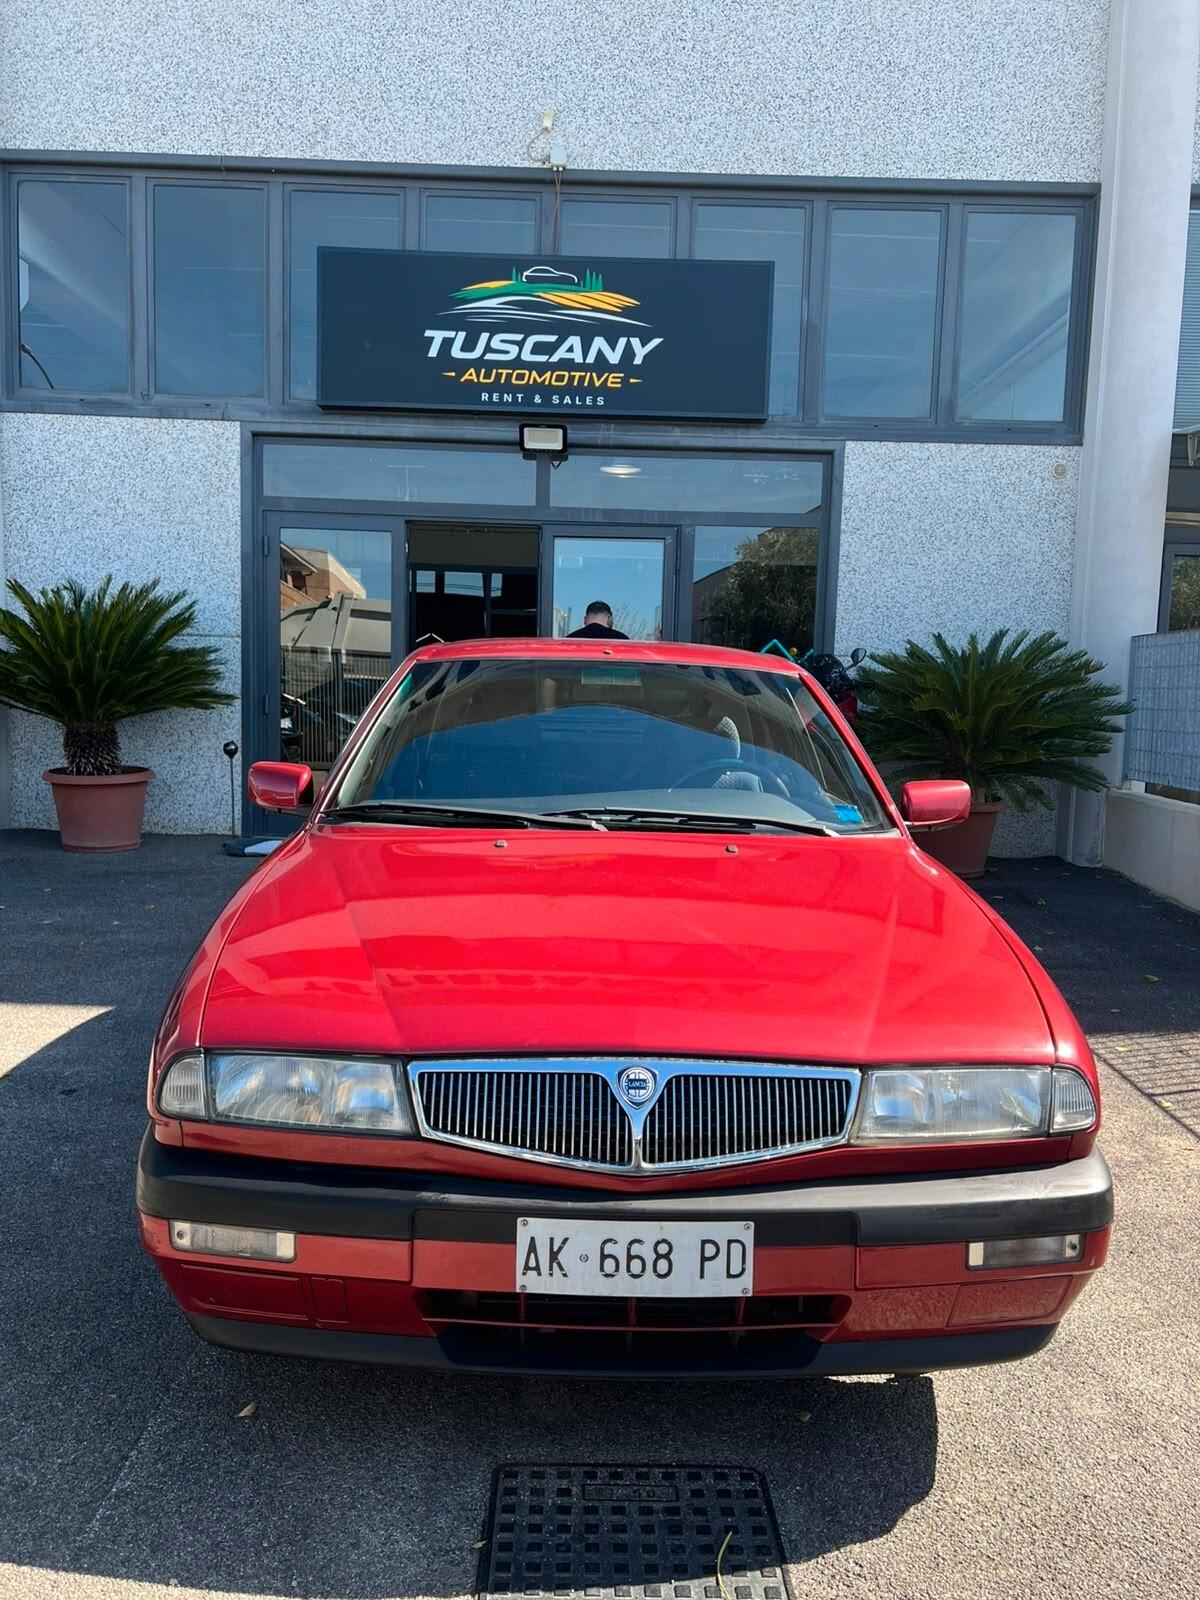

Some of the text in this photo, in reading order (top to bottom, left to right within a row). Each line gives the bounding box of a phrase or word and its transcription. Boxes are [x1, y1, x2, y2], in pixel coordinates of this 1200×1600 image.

[424, 329, 664, 365] TUSCANY
[460, 367, 625, 388] AUTOMOTIVE
[481, 392, 605, 406] RENT & SALES
[521, 1236, 747, 1280] AK 668 PD
